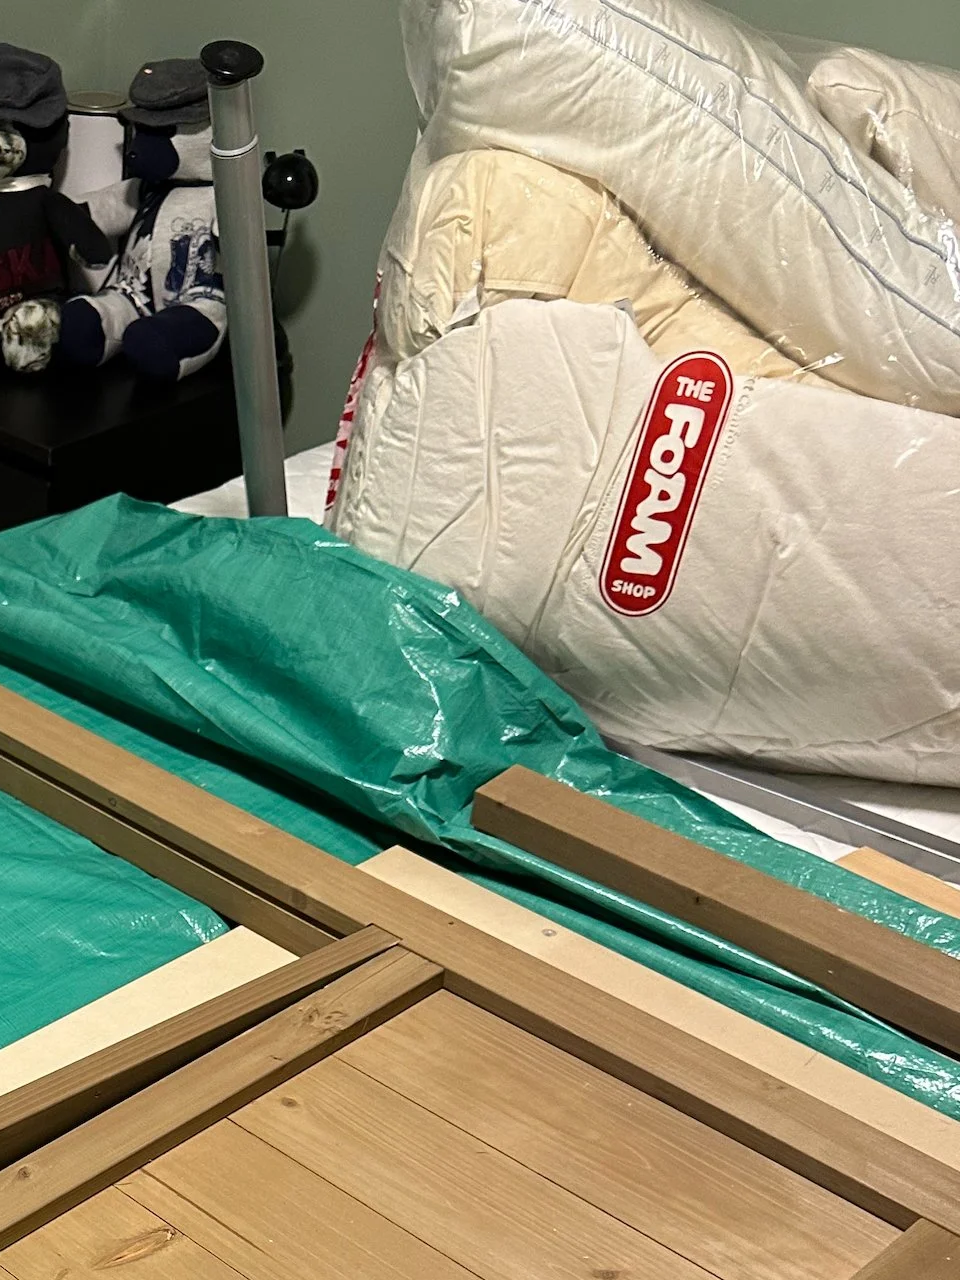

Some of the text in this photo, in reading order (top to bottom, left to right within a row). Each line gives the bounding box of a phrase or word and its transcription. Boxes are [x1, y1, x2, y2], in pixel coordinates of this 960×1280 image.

[676, 375, 716, 402] THE
[620, 403, 706, 576] FOAM
[610, 579, 656, 600] SHOP
